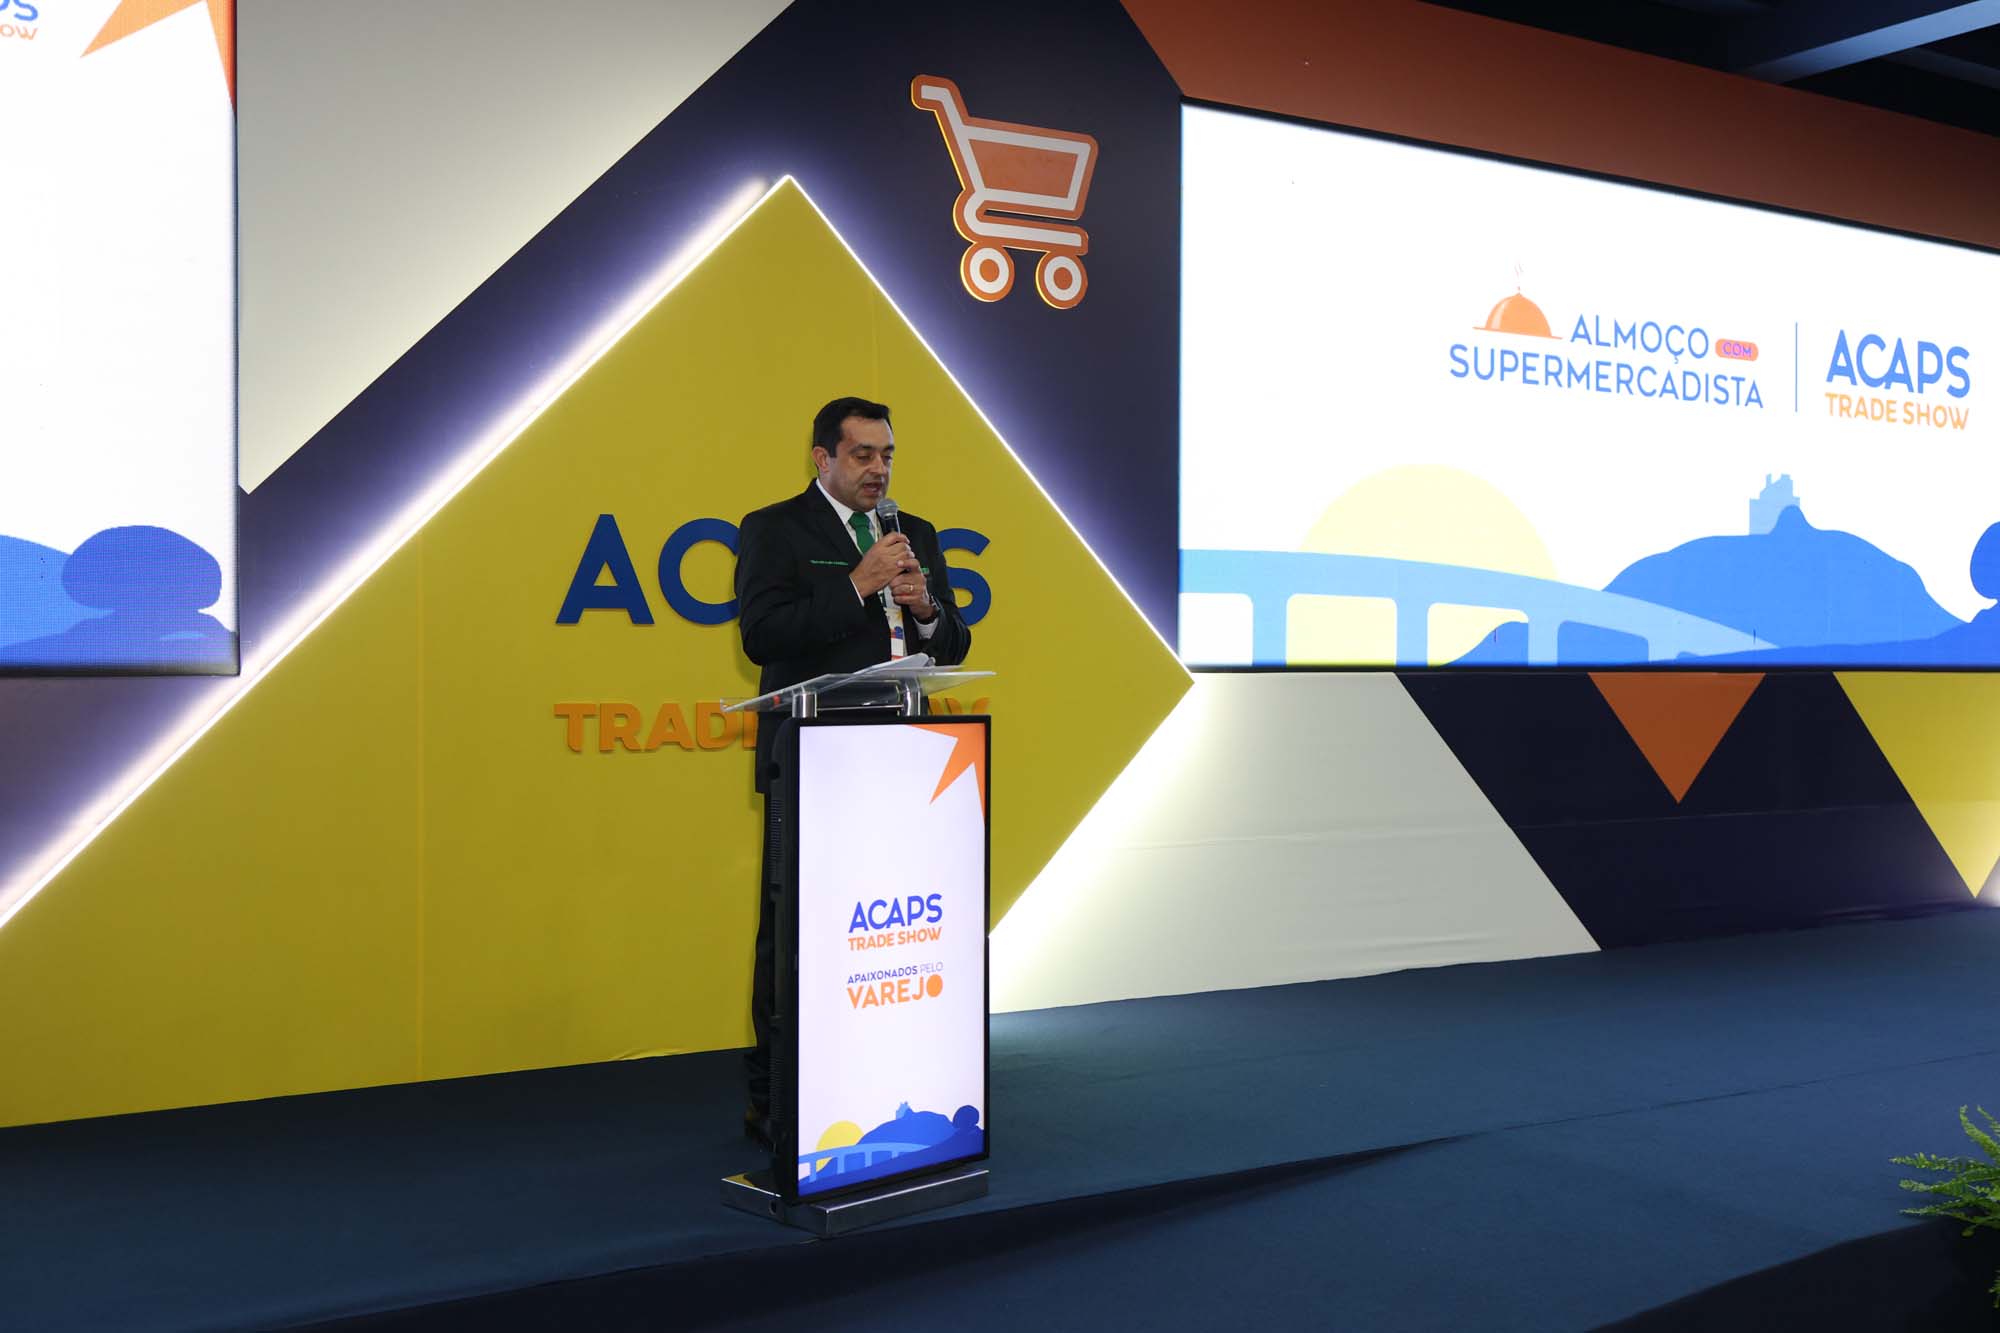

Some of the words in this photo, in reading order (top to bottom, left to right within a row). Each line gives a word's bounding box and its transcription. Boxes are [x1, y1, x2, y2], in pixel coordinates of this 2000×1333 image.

[1570, 313, 1709, 364] ALMOÇO
[1722, 342, 1752, 357] COM
[1450, 343, 1763, 409] SUPERMERCADISTA
[1826, 329, 1970, 398] ACAPS
[1825, 392, 1897, 423] TRADE
[1903, 401, 1970, 430] SHOW
[556, 513, 992, 626] ACS
[848, 893, 943, 933] ACAPS
[848, 933, 894, 951] TRADE
[898, 926, 942, 945] SHOW
[847, 965, 918, 984] APAIXONADOS
[919, 961, 943, 974] PELO
